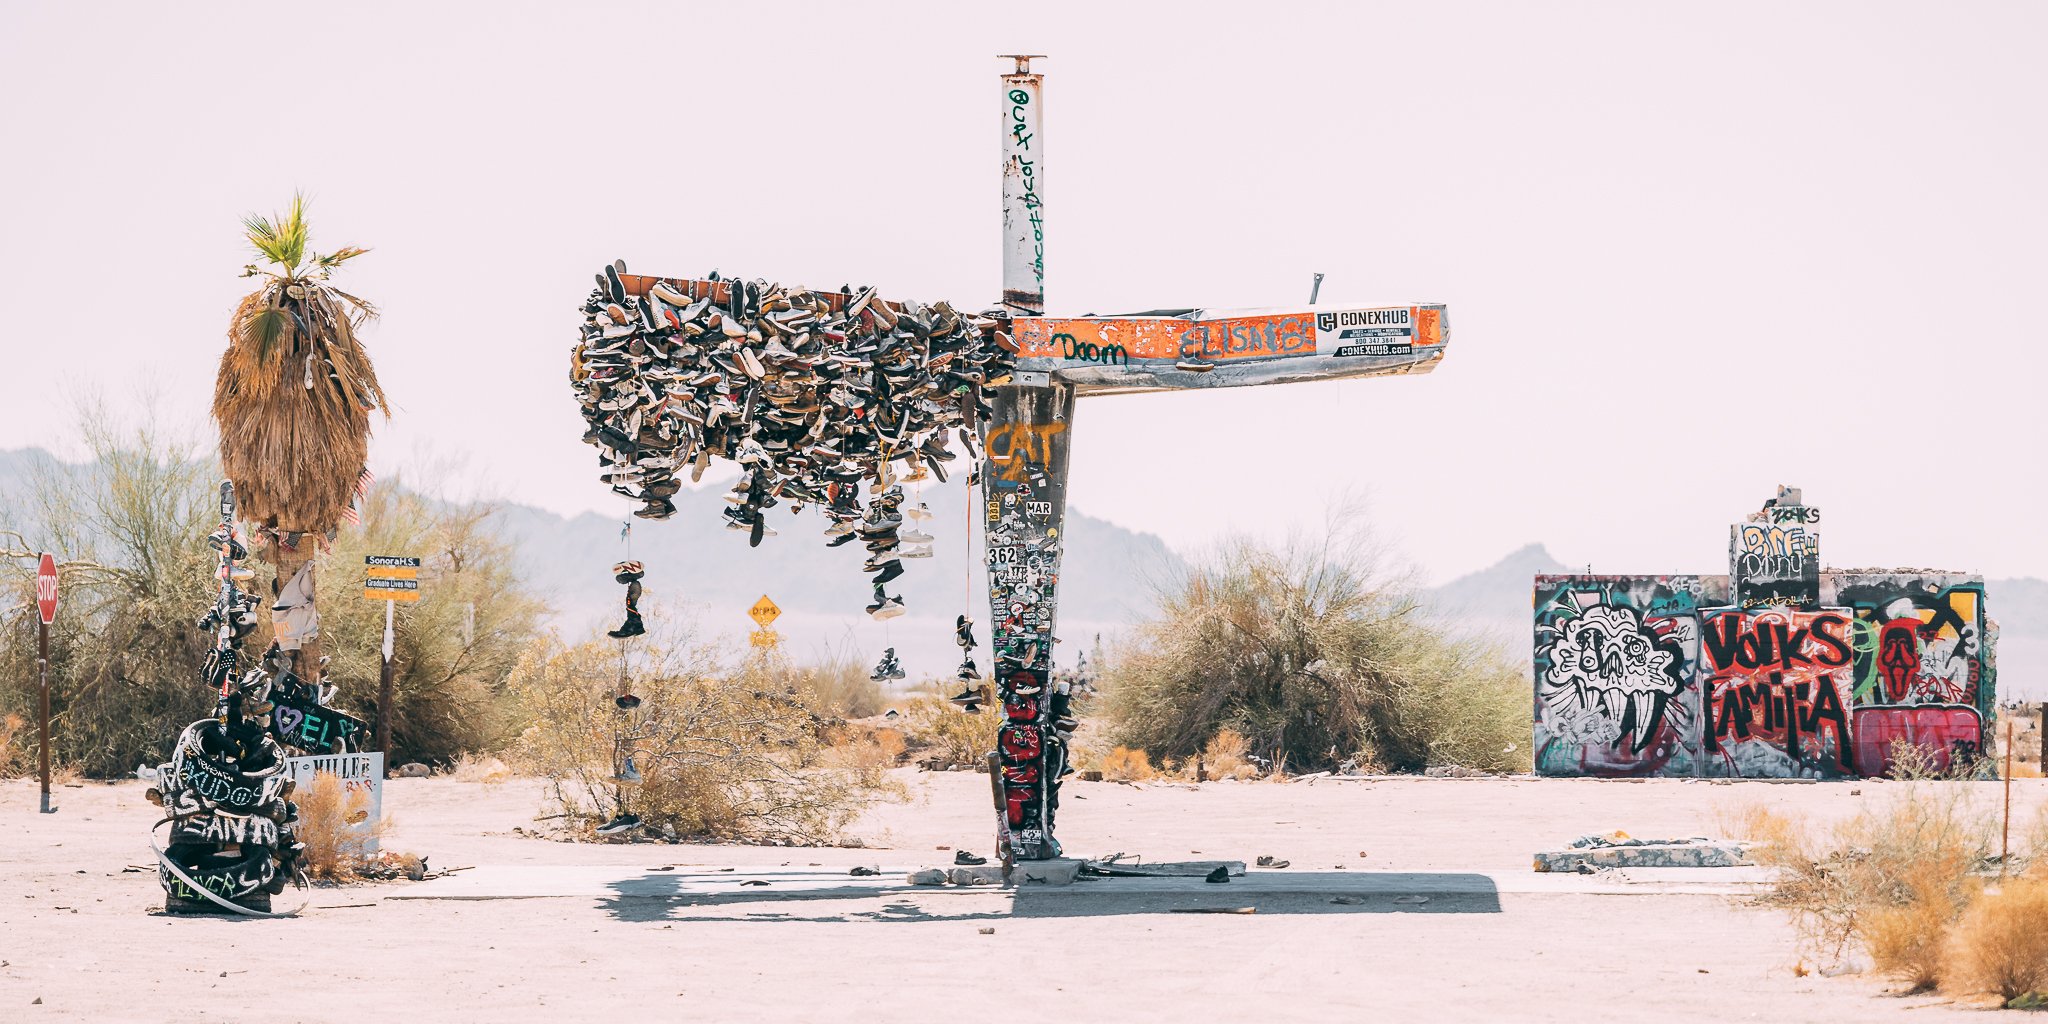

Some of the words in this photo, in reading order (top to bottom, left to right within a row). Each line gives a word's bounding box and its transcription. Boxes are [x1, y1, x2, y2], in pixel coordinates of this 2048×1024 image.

[1341, 310, 1408, 325] CONEXHUB
[1341, 345, 1411, 356] CONEXHUB.com
[985, 421, 1067, 470] CAT
[1027, 502, 1050, 514] MAR
[989, 548, 1016, 563] 362
[38, 575, 57, 601] STOP
[367, 579, 390, 588] Graduate
[390, 580, 404, 588] Lives
[404, 581, 417, 589] Here
[1960, 622, 1980, 656] 3
